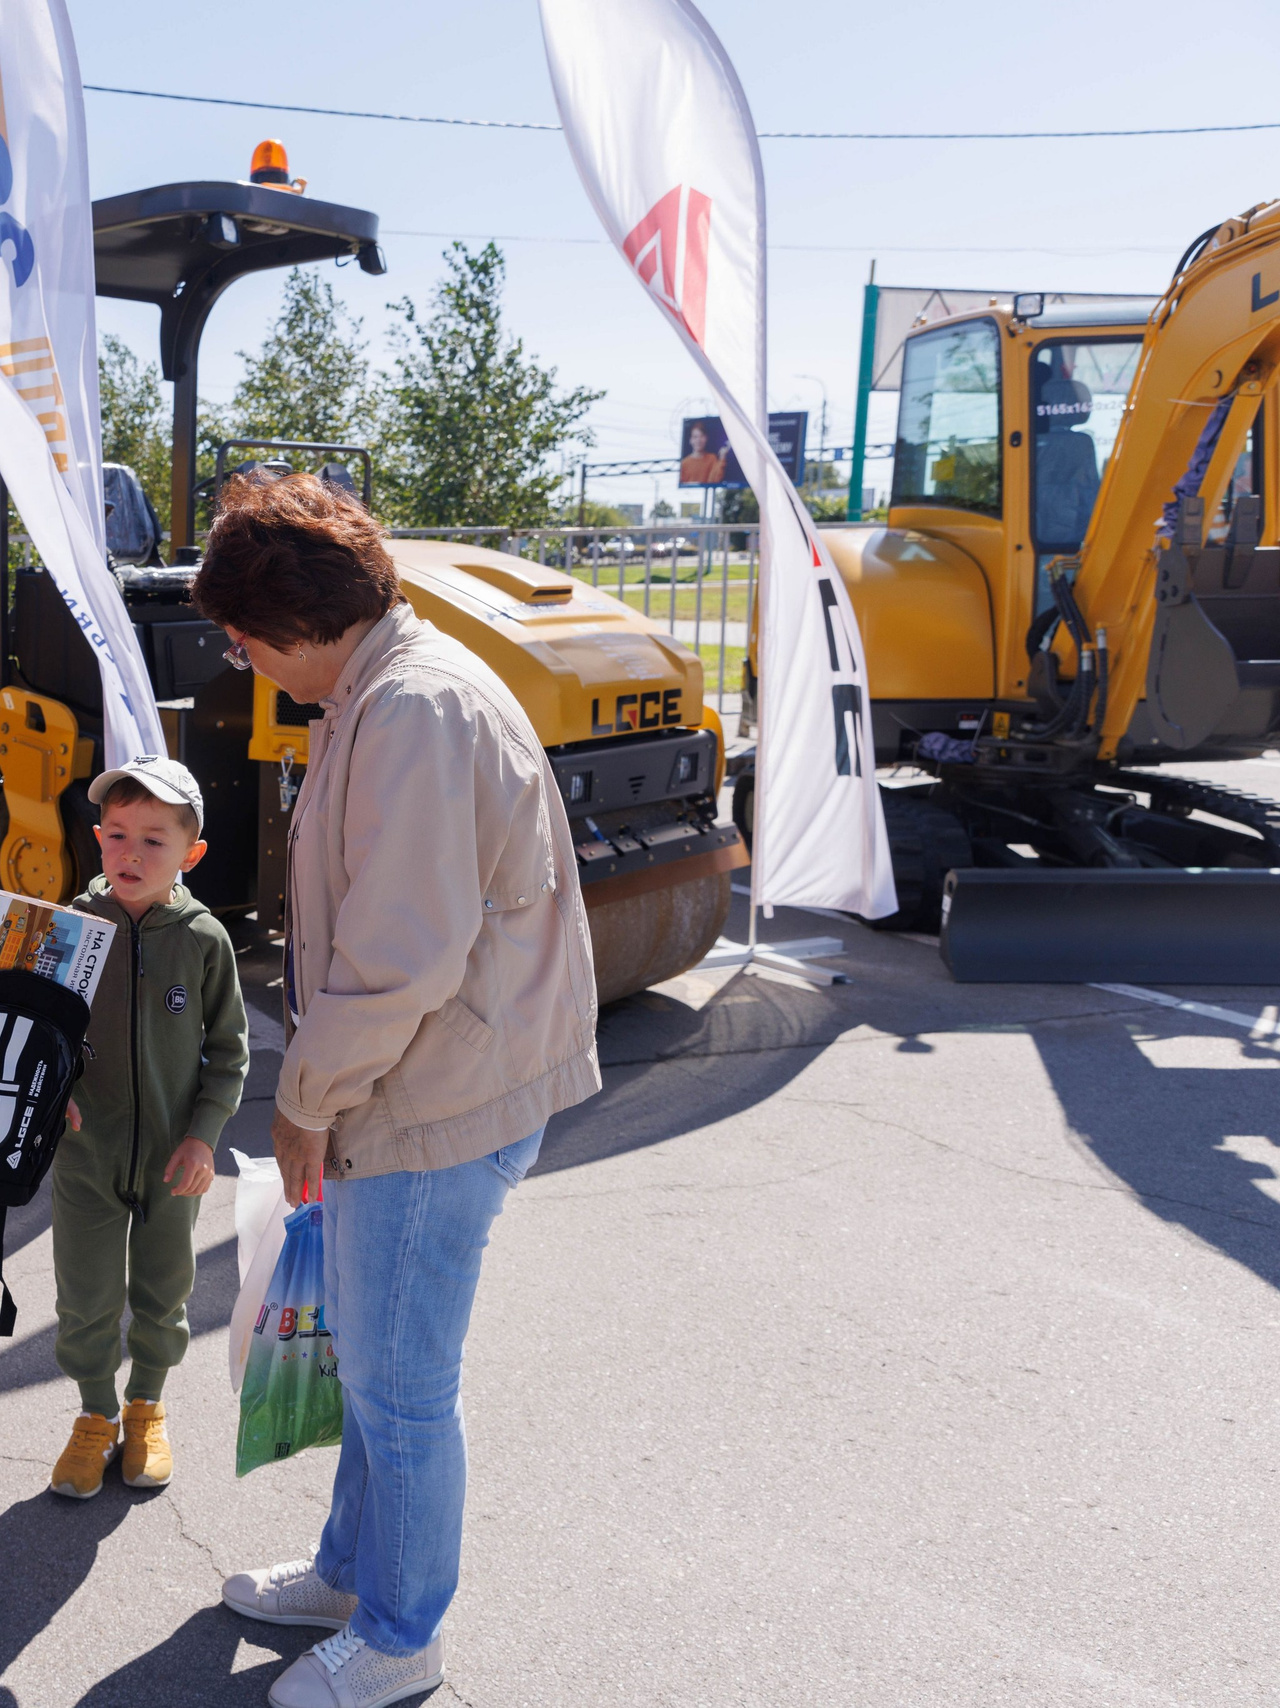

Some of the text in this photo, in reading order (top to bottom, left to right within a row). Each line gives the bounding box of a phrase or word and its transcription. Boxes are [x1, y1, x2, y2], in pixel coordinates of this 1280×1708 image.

[591, 688, 682, 736] LGCE
[72, 929, 94, 979] настольная
[90, 931, 107, 951] НА
[15, 1106, 35, 1148] LGCE
